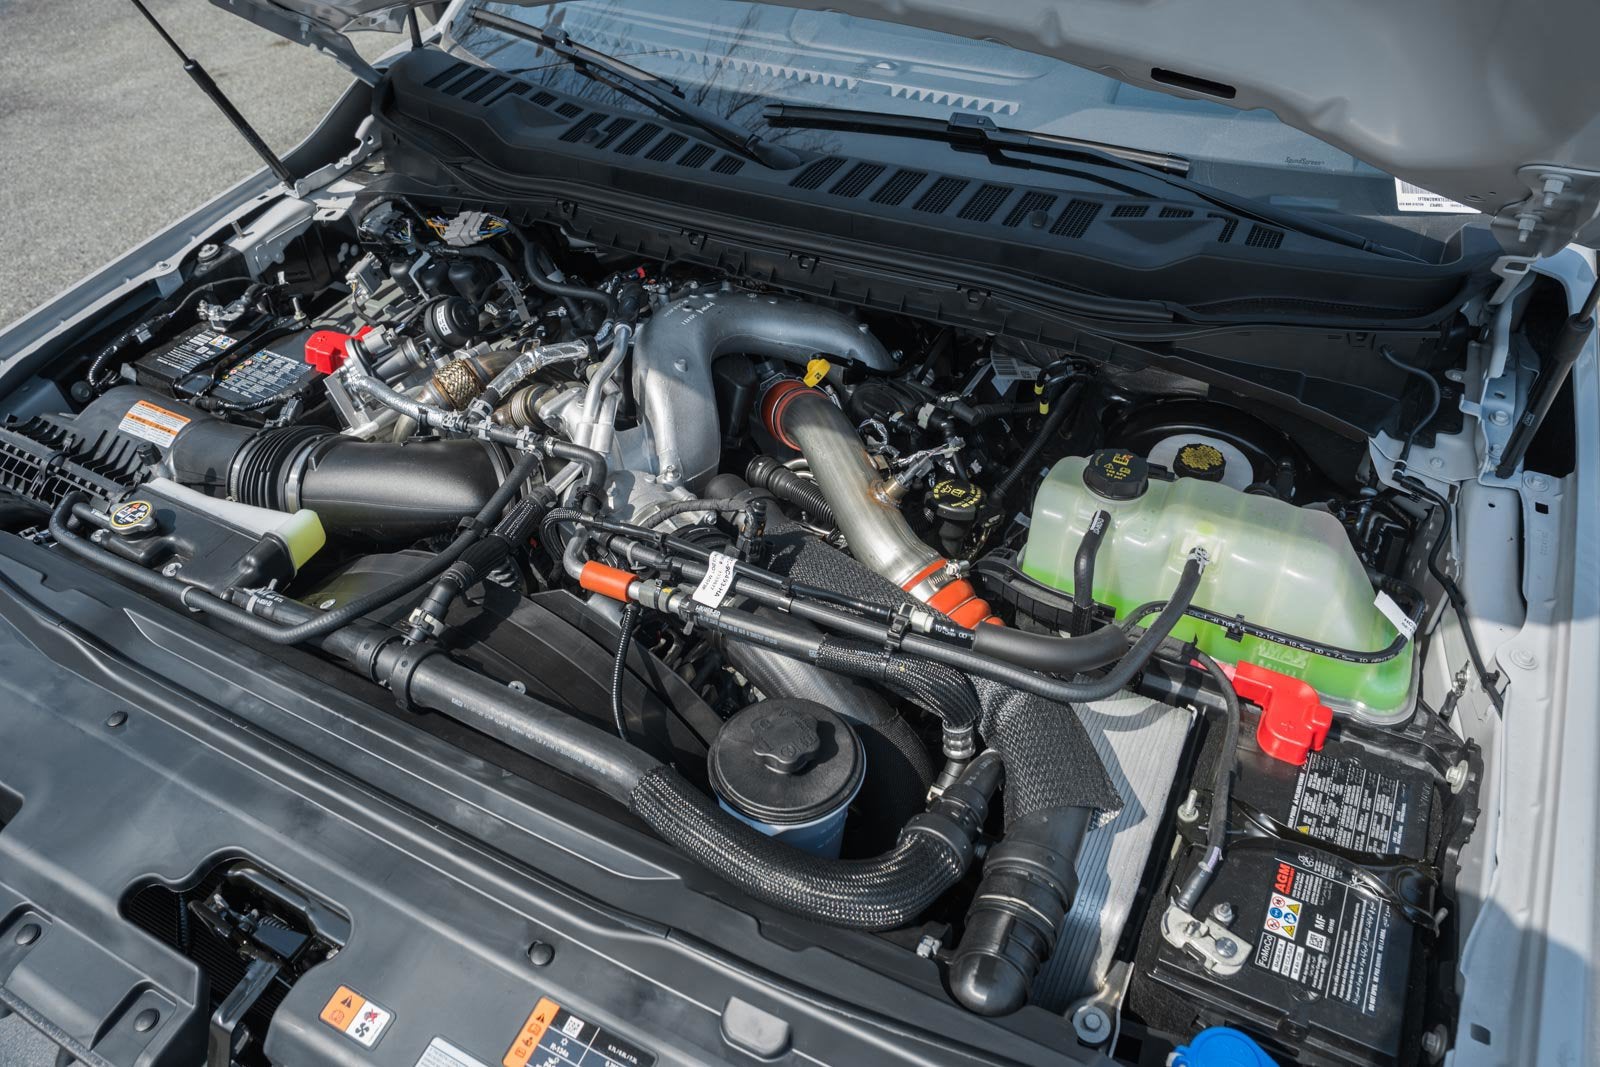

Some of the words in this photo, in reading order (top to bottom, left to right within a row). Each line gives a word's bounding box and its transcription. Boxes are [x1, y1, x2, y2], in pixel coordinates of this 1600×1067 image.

[1275, 863, 1291, 893] AGM
[1314, 914, 1326, 930] MF
[1258, 935, 1273, 967] FoMoCo
[550, 1042, 570, 1058] R-134a
